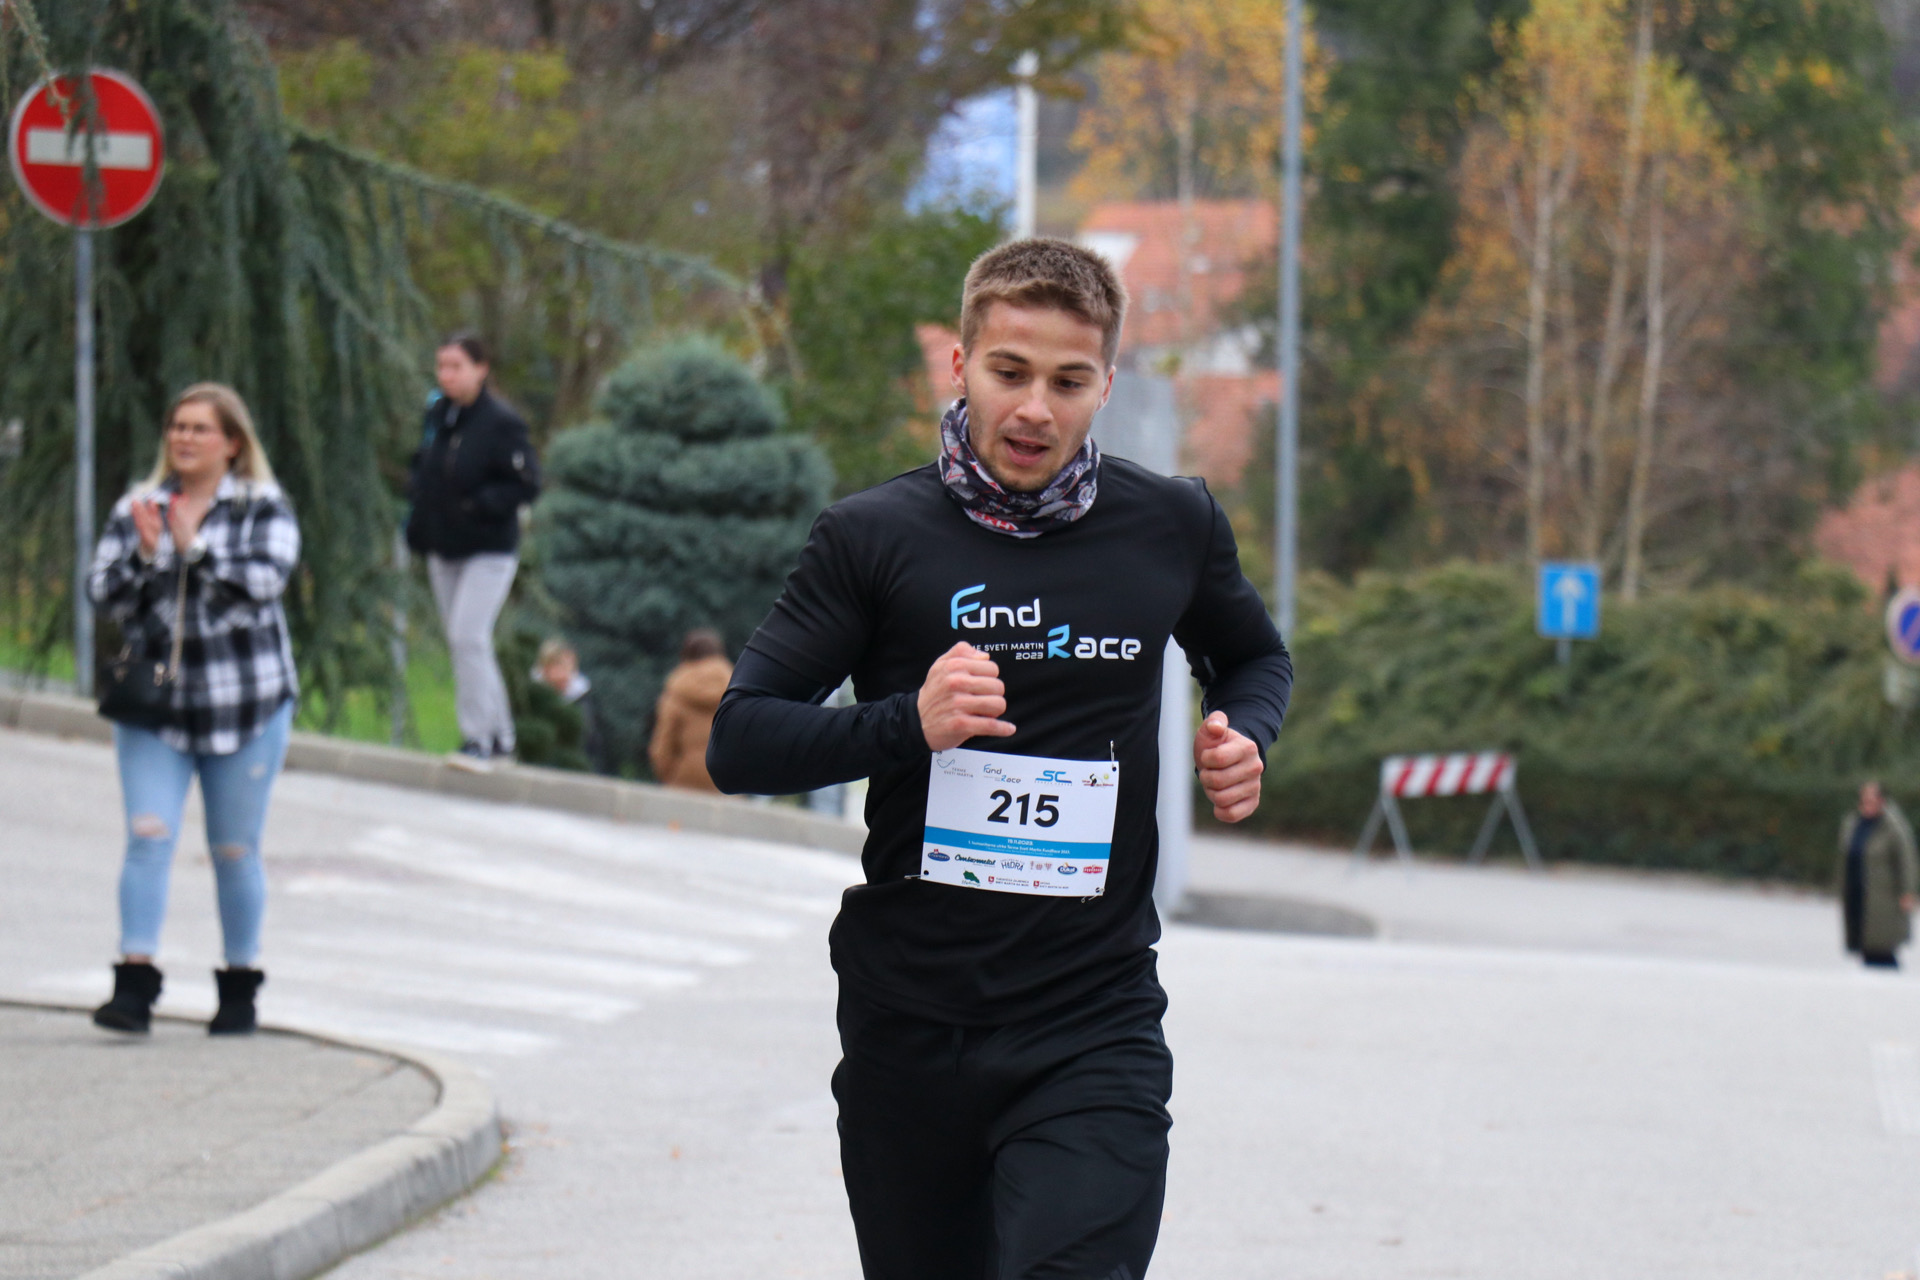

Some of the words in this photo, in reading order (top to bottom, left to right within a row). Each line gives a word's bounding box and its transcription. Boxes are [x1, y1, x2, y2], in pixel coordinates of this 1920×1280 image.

[951, 583, 1041, 630] Fund
[984, 643, 1008, 652] SVETI
[1010, 642, 1044, 651] MARTIN
[1047, 624, 1142, 661] Race
[1015, 651, 1044, 660] 2023
[983, 763, 1002, 775] Fund
[1035, 770, 1072, 784] SC
[987, 789, 1060, 828] 215
